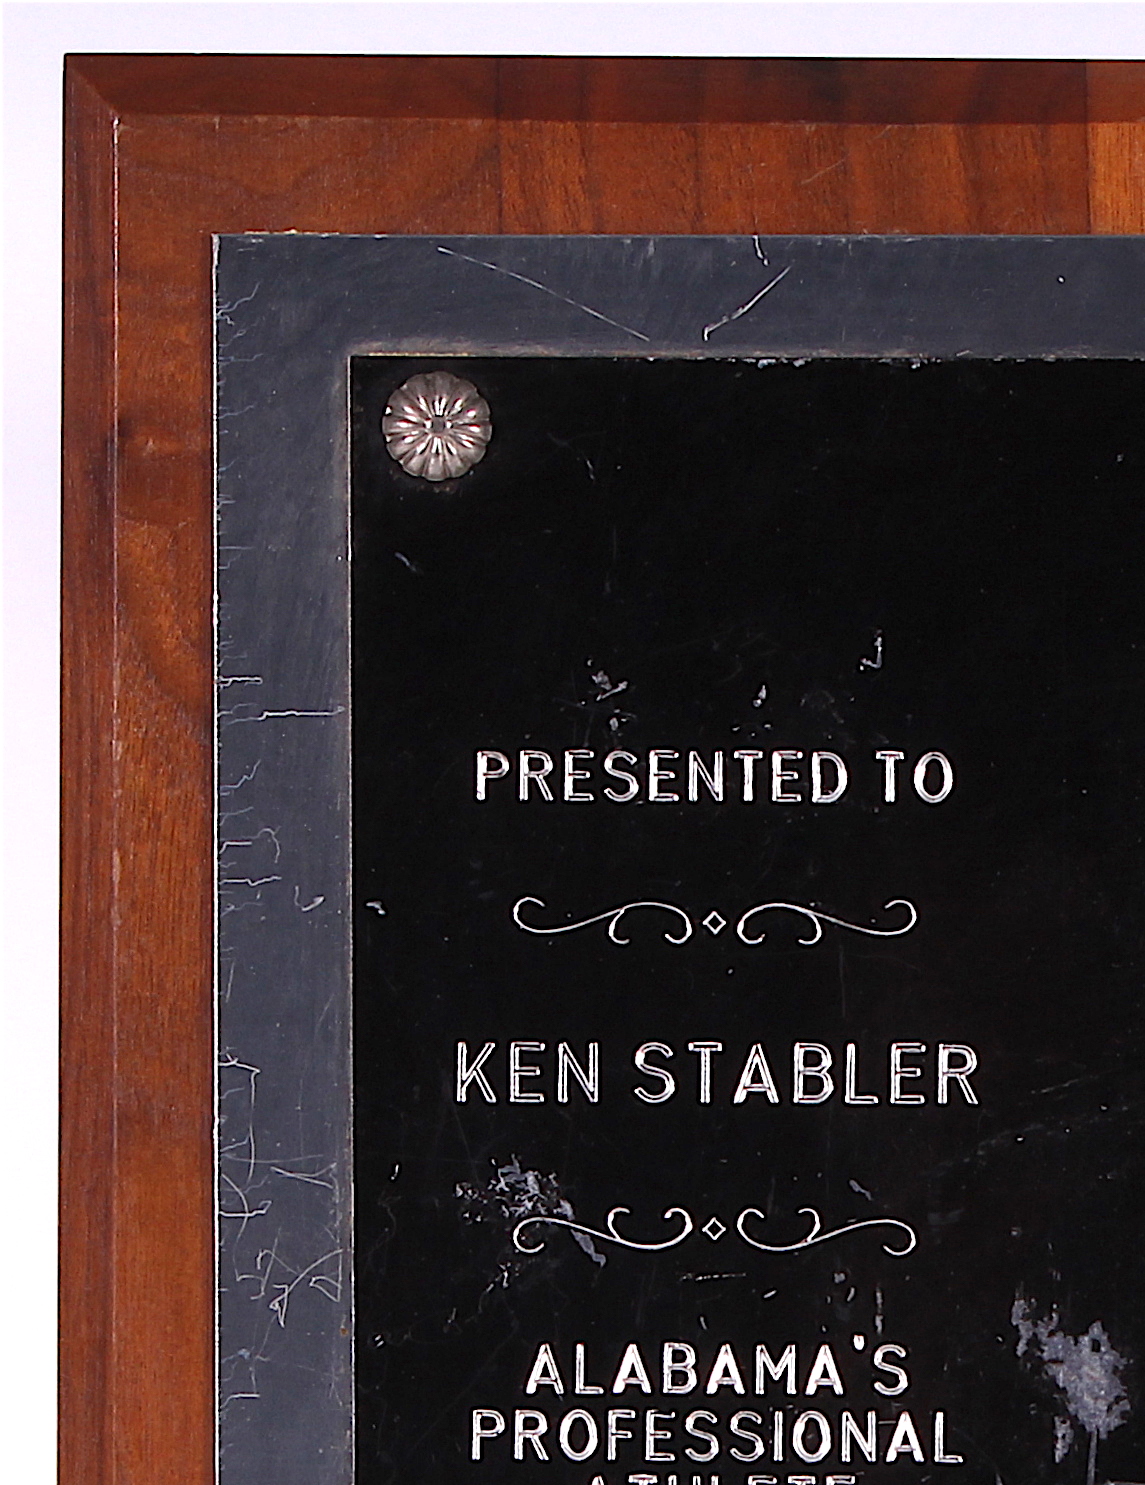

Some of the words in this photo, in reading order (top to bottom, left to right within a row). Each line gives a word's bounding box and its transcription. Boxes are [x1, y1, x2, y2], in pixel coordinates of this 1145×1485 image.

[476, 750, 849, 803] PRESENTED
[875, 750, 955, 804] TO
[456, 1041, 600, 1104] KEN
[634, 1041, 981, 1105] STABLER
[525, 1335, 910, 1396] ALABAMA'S
[470, 1408, 964, 1464] PROFESSIONAL
